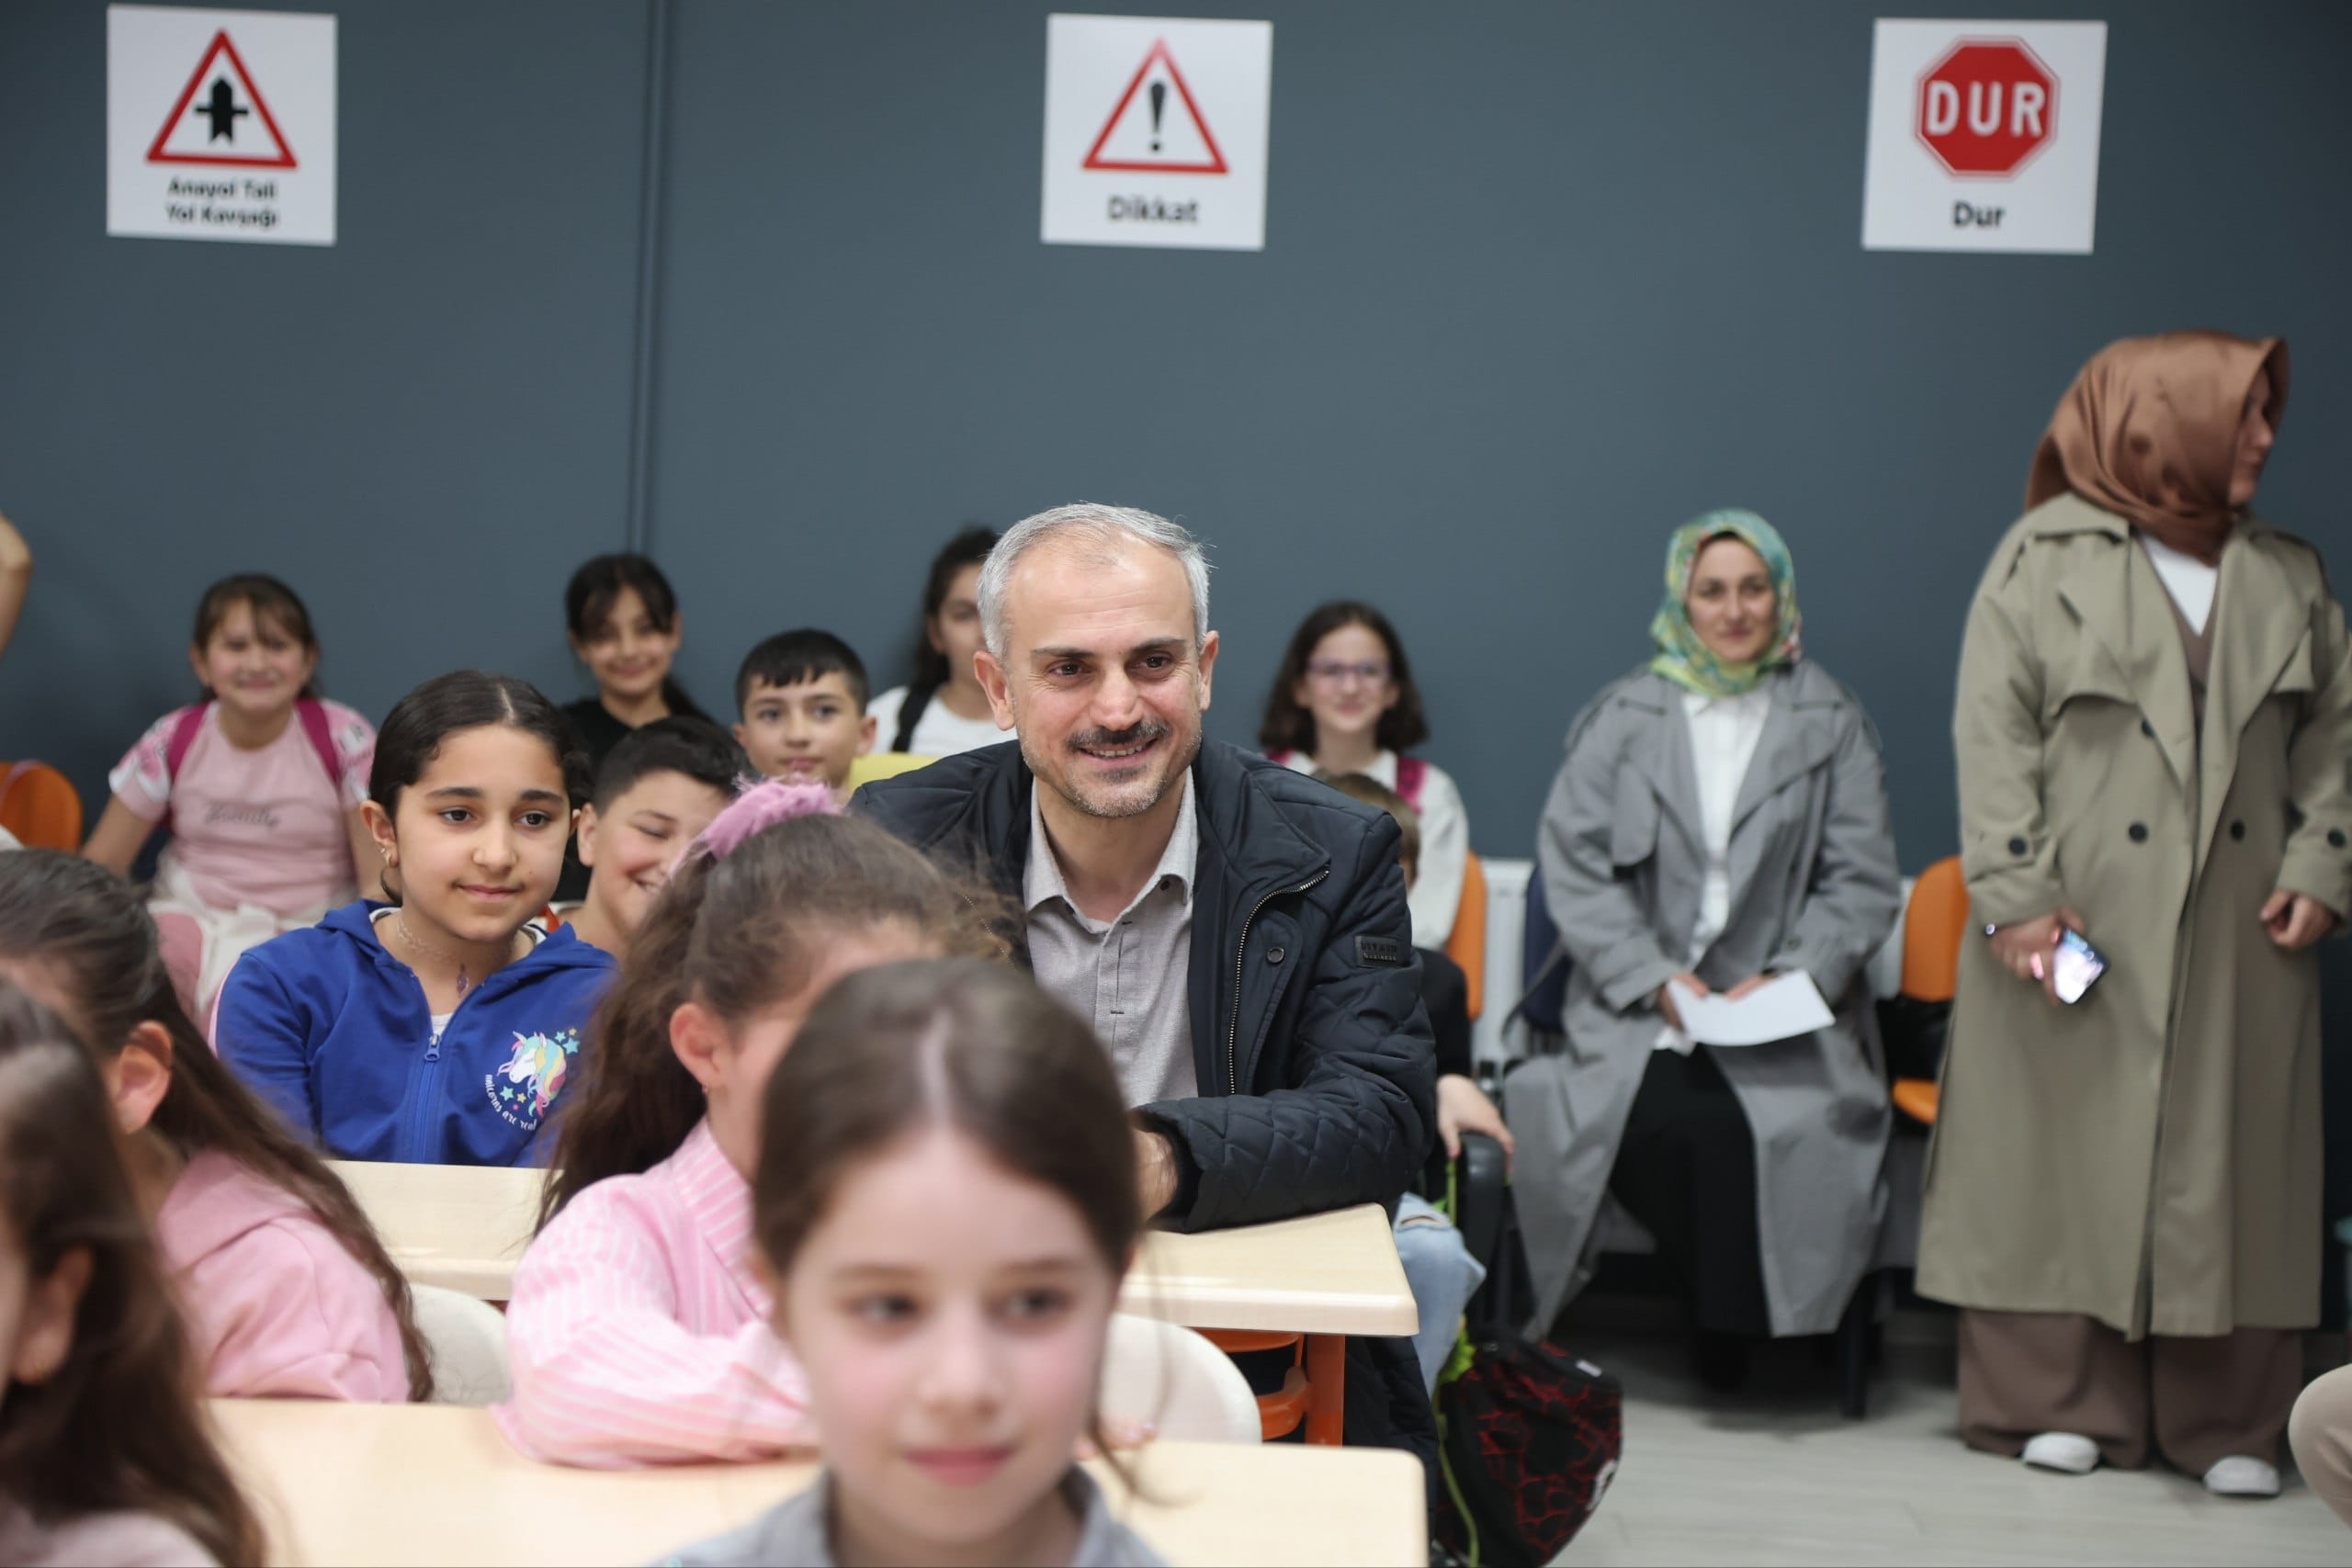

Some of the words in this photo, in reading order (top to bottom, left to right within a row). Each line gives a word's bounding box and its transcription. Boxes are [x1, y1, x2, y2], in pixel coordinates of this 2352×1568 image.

[1926, 80, 2046, 137] DUR
[1108, 196, 1199, 221] Dikkat
[1953, 200, 2005, 227] Dur
[502, 1111, 517, 1125] are
[520, 1119, 537, 1131] real
